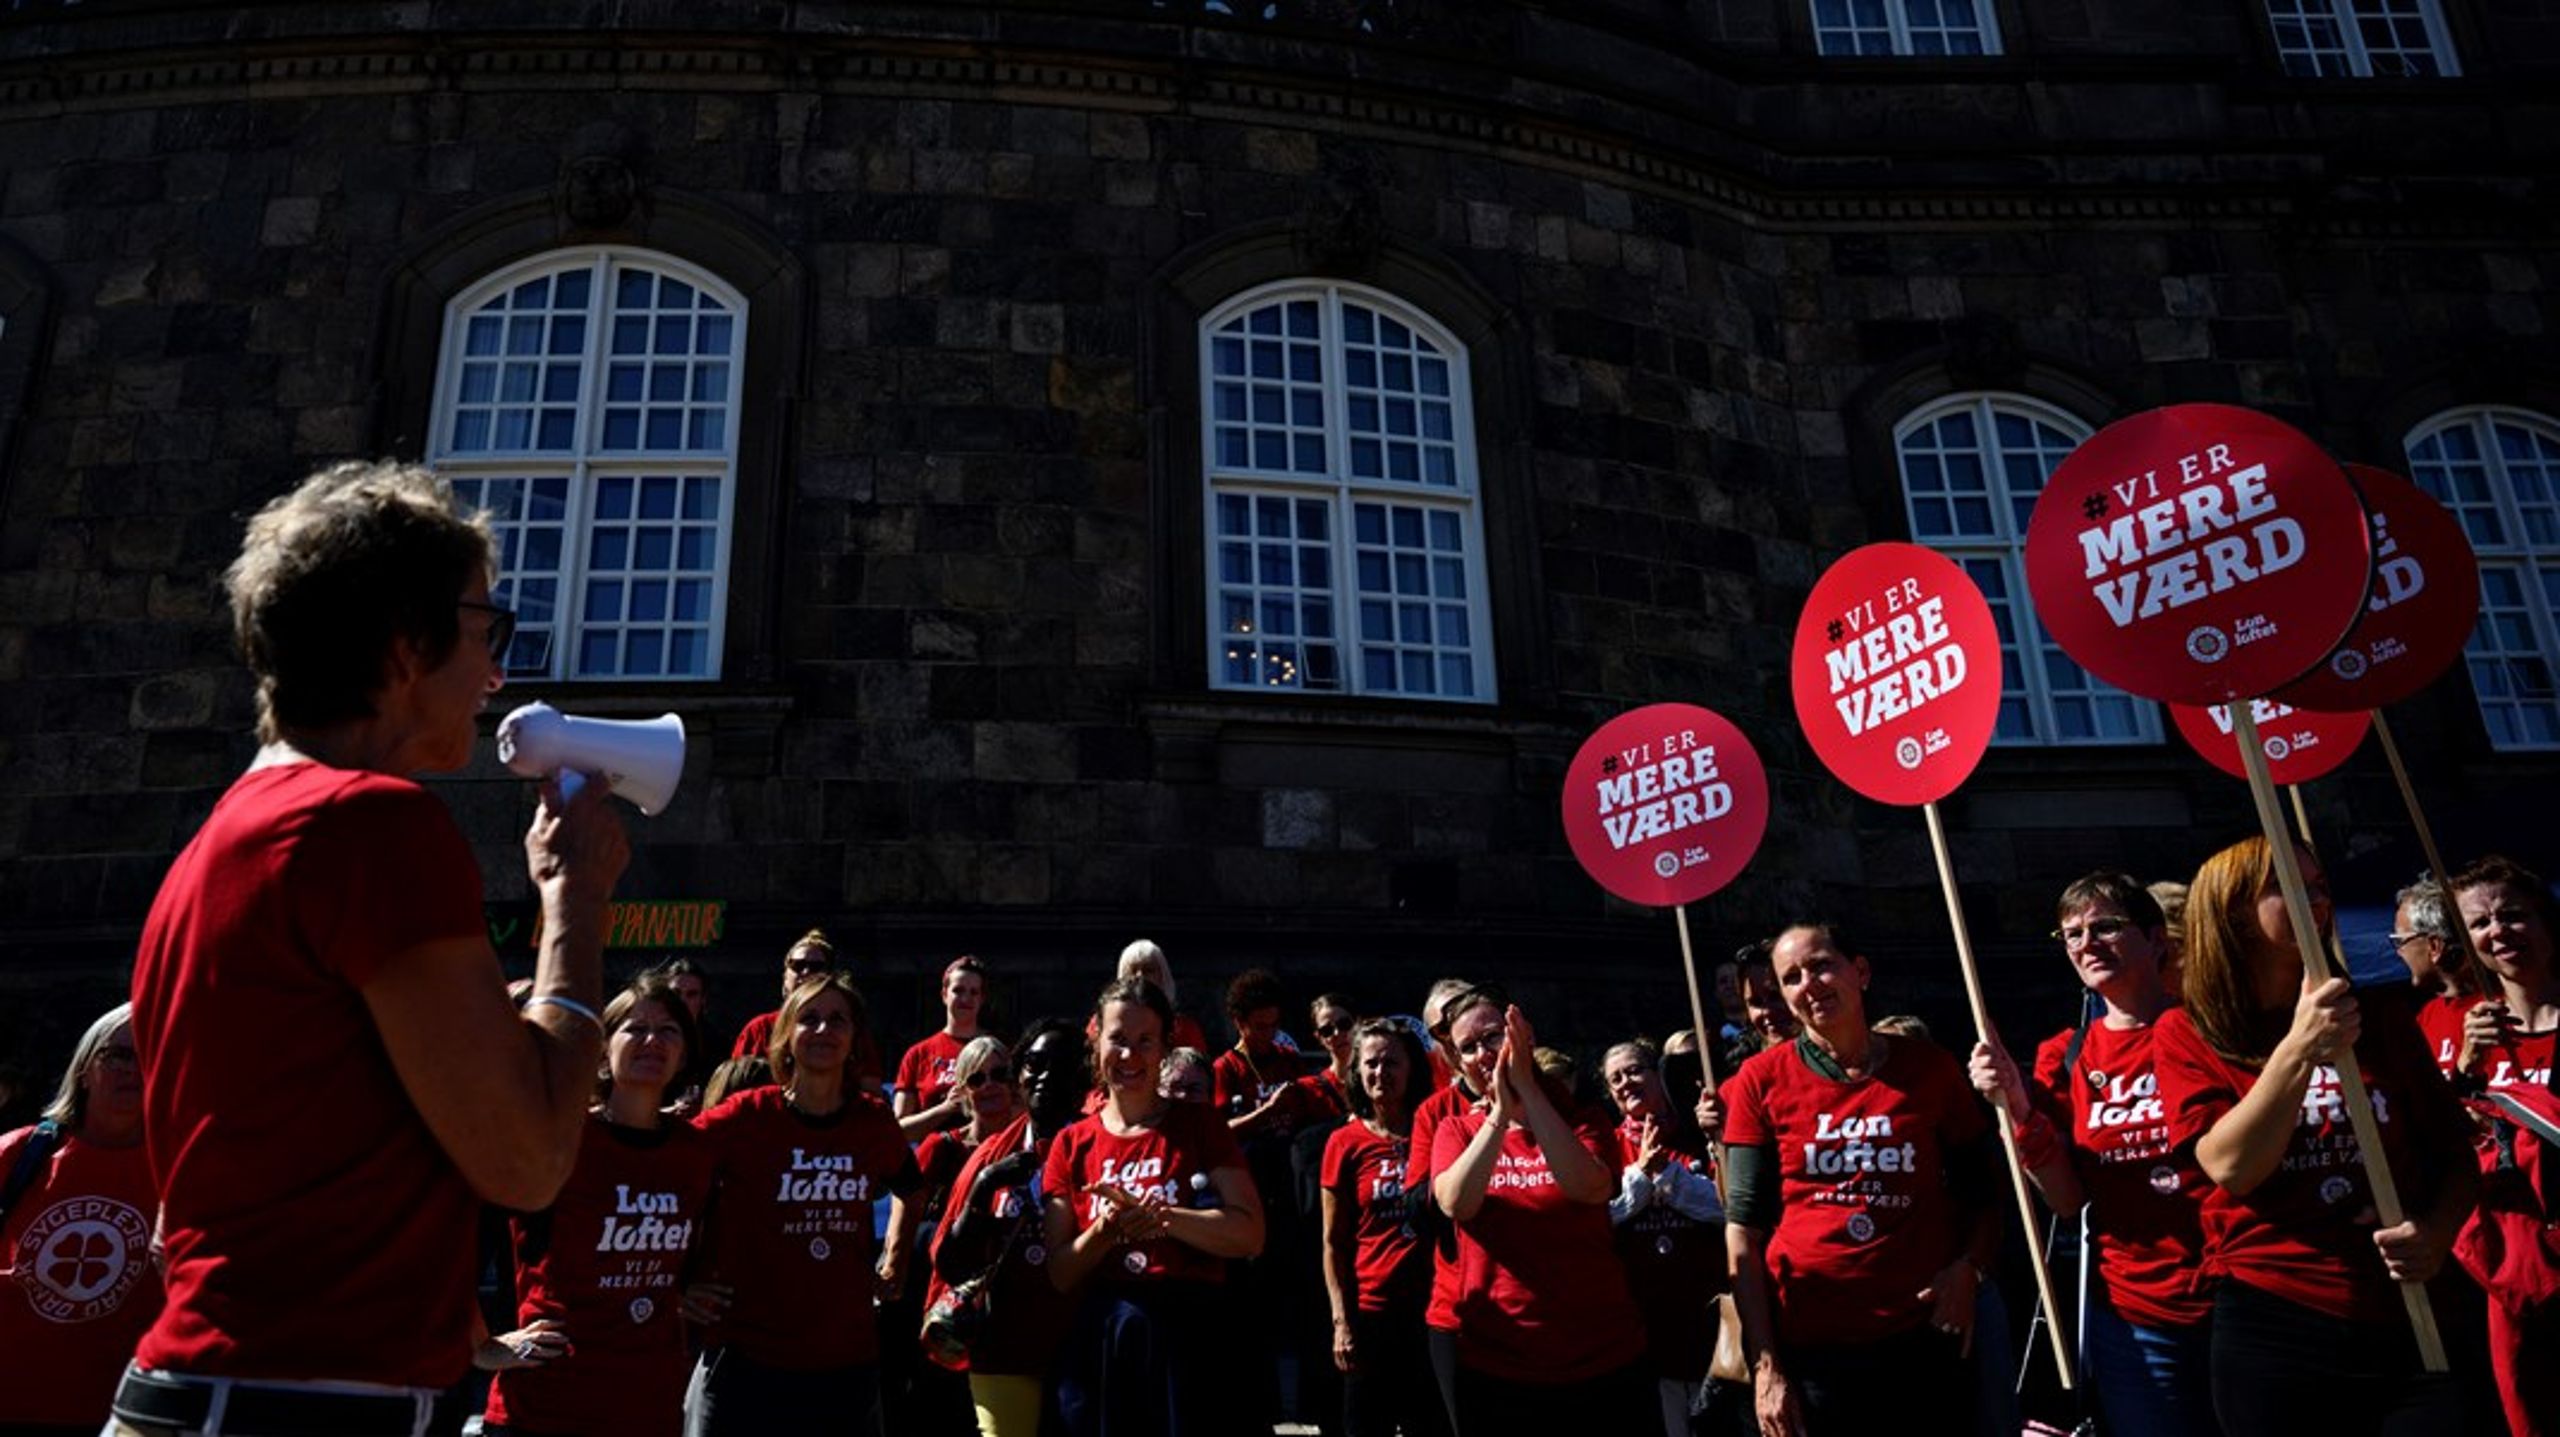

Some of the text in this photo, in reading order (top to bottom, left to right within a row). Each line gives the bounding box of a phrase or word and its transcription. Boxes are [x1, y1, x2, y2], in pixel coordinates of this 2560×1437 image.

[2177, 443, 2236, 484] ER
[2077, 462, 2278, 580] MERE
[1885, 577, 1922, 614] ER
[2092, 516, 2306, 628] VÆRD
[1824, 595, 1949, 695] MERE
[1835, 642, 1967, 738] VÆRD
[1663, 730, 1698, 756] ER
[1596, 745, 1720, 815] MERE
[1602, 782, 1733, 850] VÆRD
